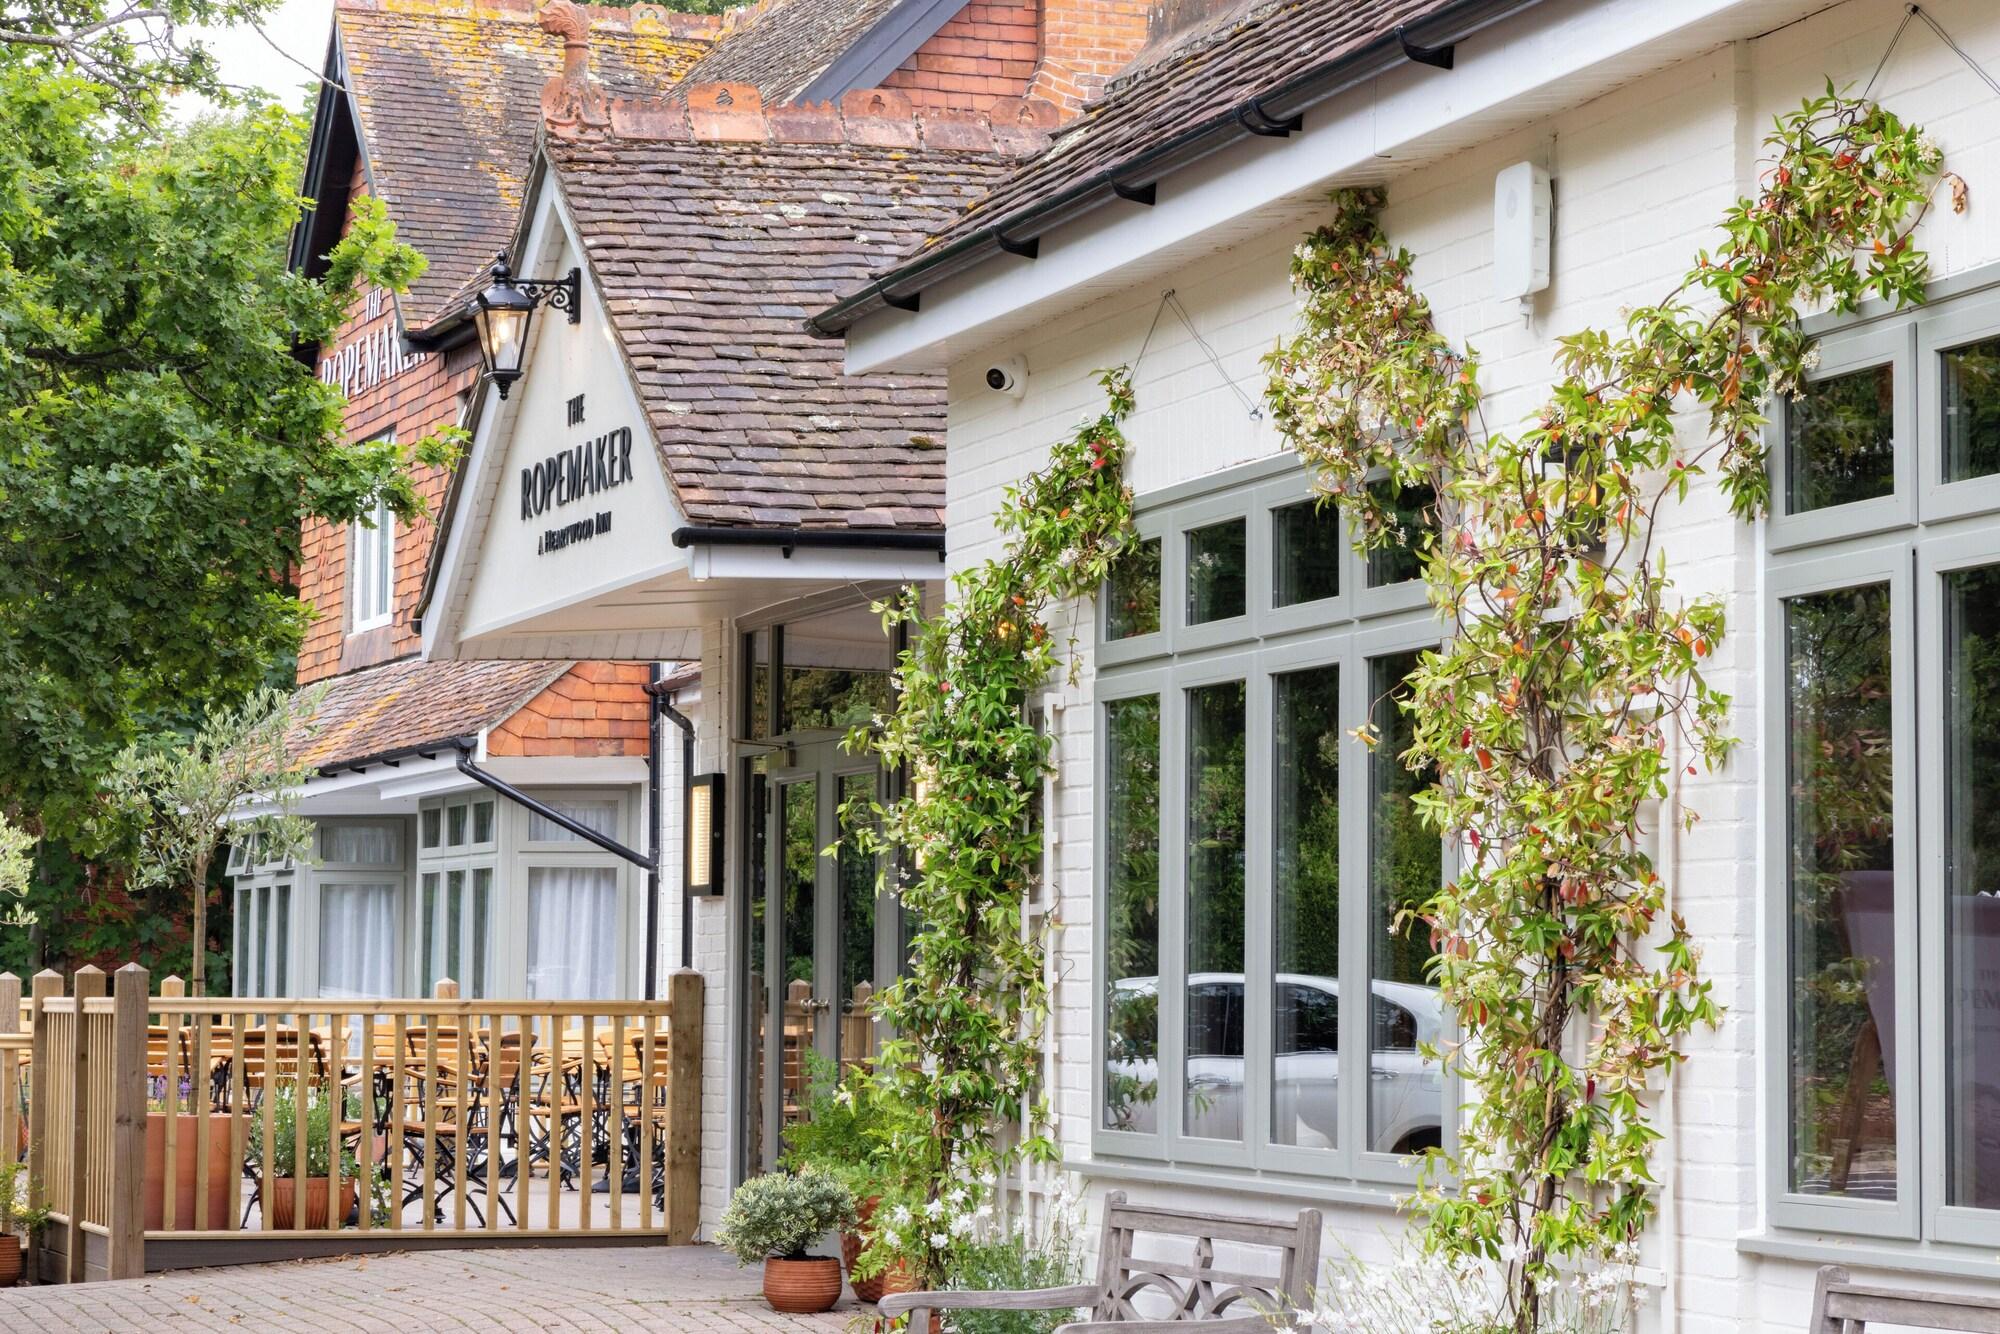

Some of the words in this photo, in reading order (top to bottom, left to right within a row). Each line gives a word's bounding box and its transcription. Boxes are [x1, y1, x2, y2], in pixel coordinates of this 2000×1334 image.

[365, 287, 383, 323] THE
[321, 318, 427, 399] ROPEMAK
[566, 393, 585, 427] THE
[520, 426, 633, 521] ROPEMAKER
[538, 535, 545, 556] A
[595, 511, 612, 535] INN
